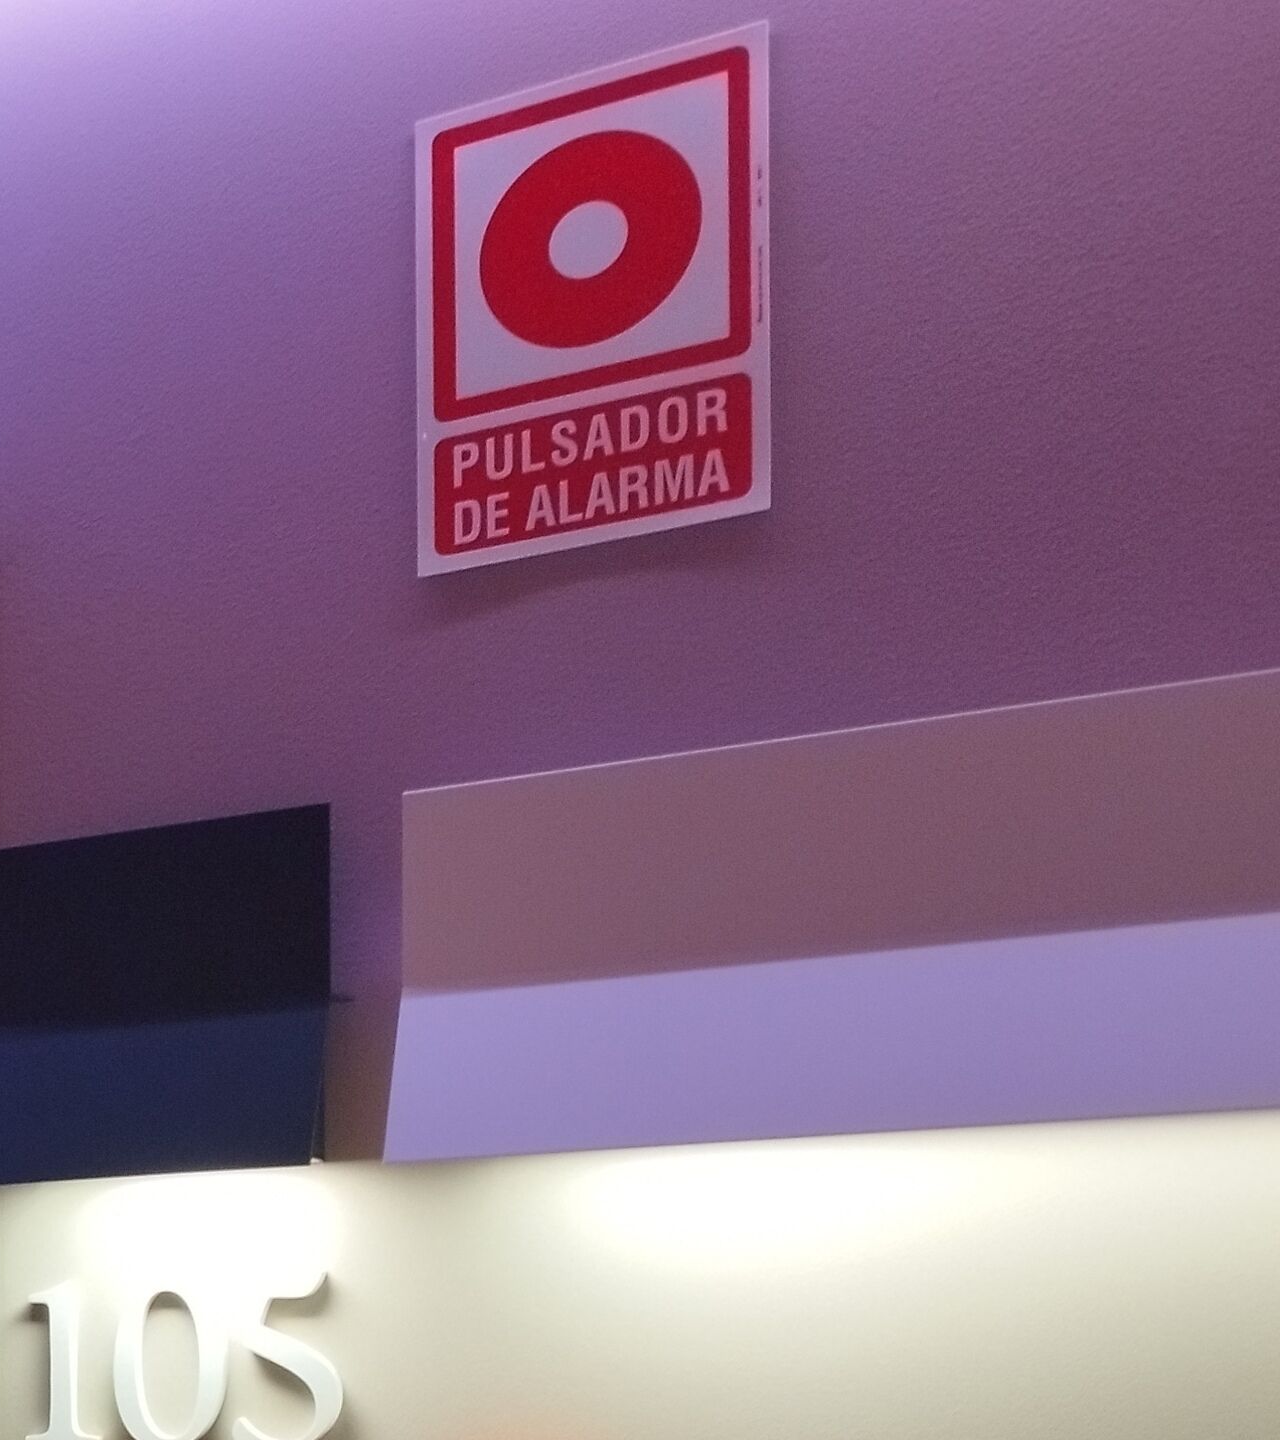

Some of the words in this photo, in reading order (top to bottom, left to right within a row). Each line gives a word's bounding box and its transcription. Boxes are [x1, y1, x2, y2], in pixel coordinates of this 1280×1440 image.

[452, 387, 729, 488] PULSADOR
[453, 492, 510, 546] DE
[525, 448, 730, 532] ALARMA
